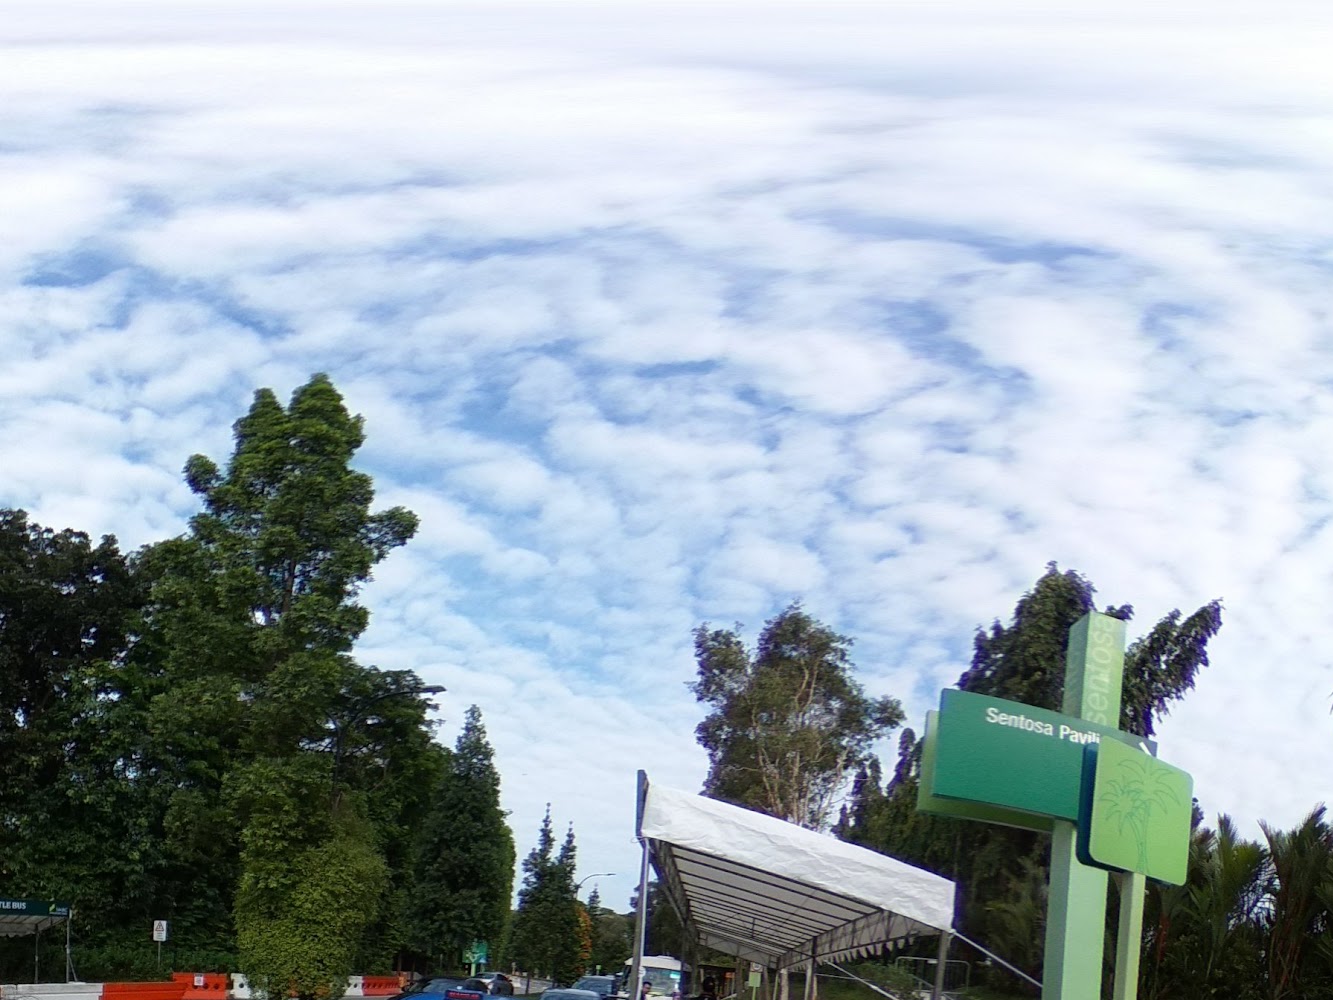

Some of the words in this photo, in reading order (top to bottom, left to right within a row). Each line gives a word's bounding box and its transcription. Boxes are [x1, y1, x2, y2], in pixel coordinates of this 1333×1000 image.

[986, 707, 1053, 736] Sentosa
[1059, 725, 1100, 745] Pavili
[12, 901, 26, 910] BUS
